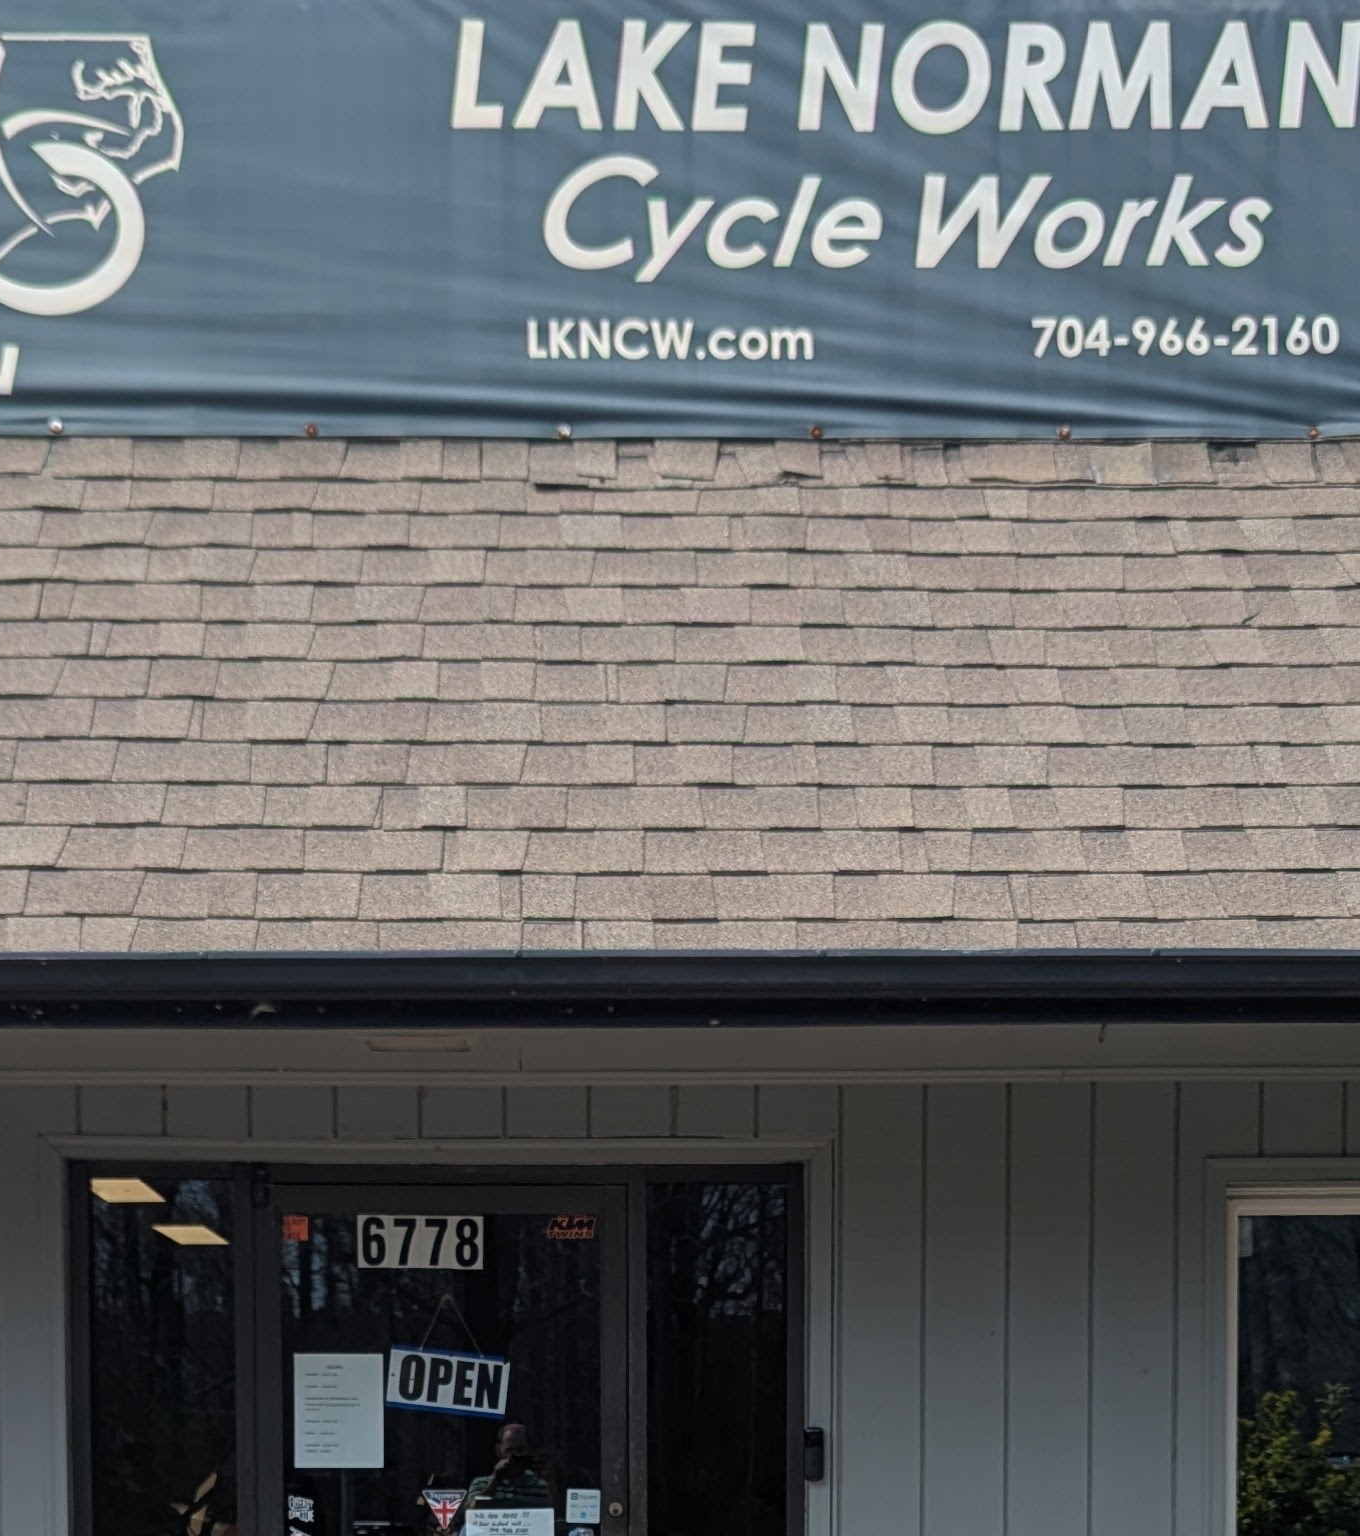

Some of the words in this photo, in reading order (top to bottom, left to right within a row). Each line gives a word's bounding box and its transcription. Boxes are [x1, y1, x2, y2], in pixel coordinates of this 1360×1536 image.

[451, 17, 757, 132] LAKE
[543, 153, 883, 283] Cycle
[915, 172, 1273, 270] Works
[527, 317, 815, 361] LKNCW.com
[1031, 314, 1341, 360] 704-966-2160
[361, 1216, 480, 1268] 6778
[549, 1216, 594, 1230] KTM
[397, 1353, 504, 1411] OPEN
